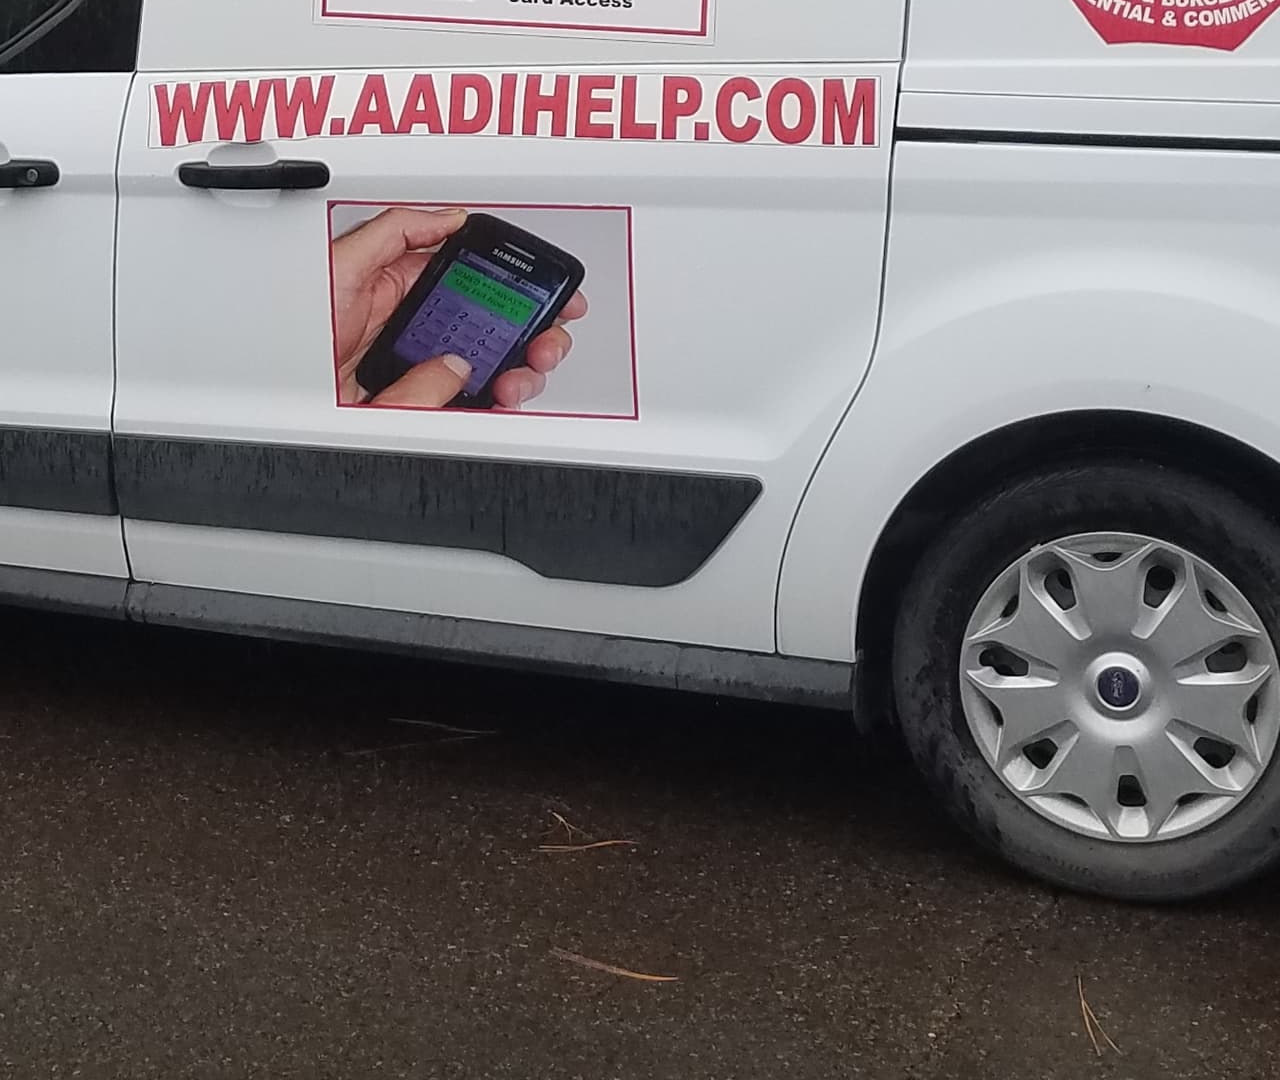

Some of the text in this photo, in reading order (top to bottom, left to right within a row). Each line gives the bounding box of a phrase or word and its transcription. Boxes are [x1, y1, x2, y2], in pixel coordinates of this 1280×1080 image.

[1161, 10, 1177, 27] &
[153, 72, 876, 146] WWW.AADIHELP.COM
[492, 248, 535, 273] SAMSUNG
